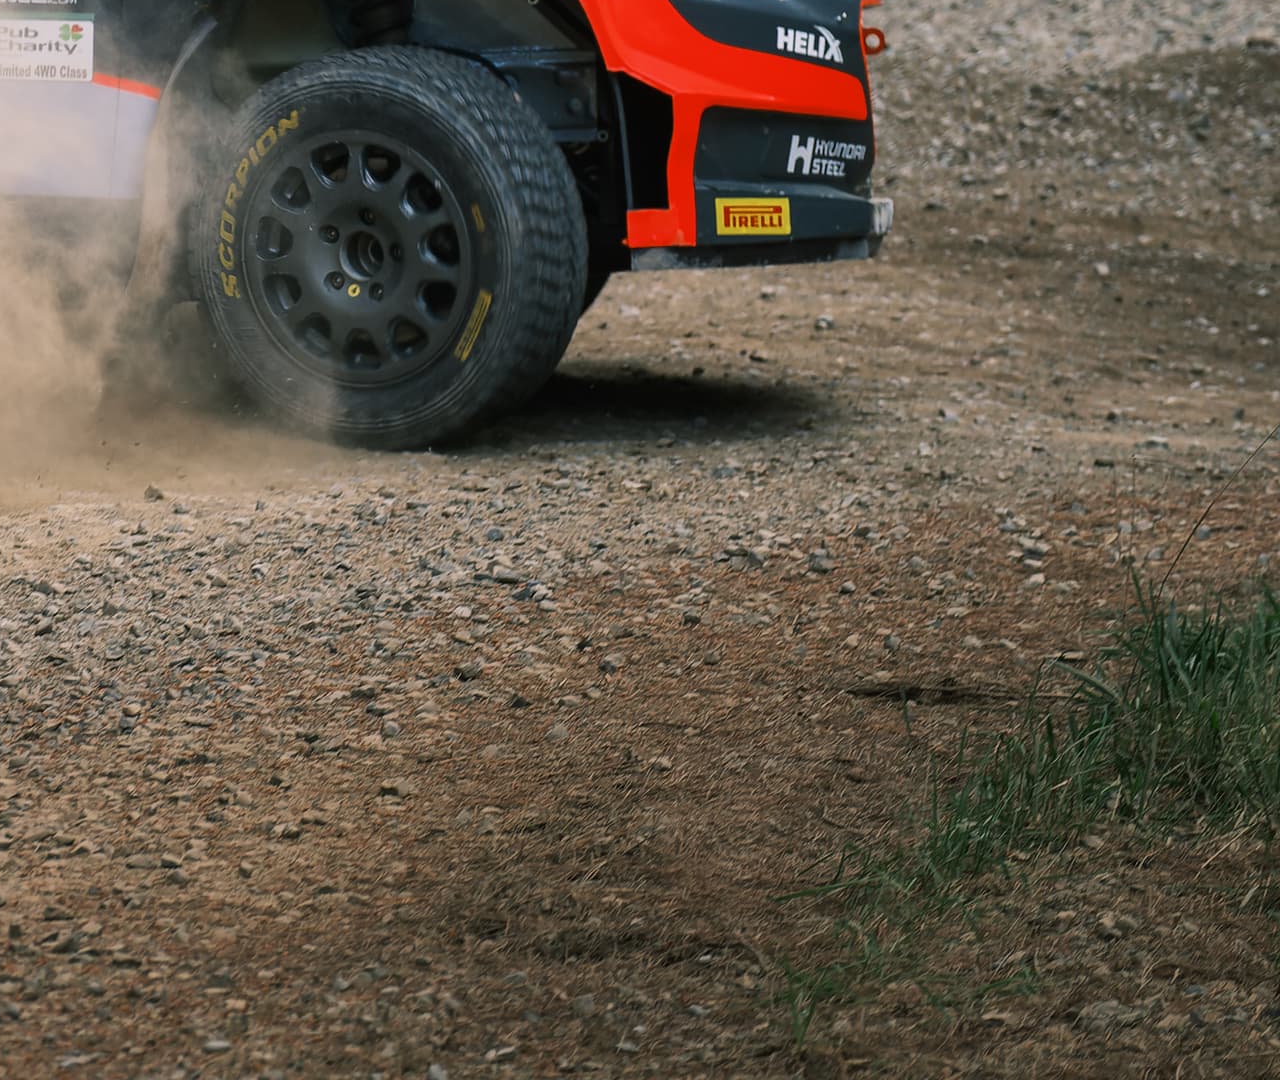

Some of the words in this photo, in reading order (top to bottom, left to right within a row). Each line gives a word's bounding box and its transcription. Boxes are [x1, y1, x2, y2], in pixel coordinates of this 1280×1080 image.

[776, 24, 844, 64] HELIX
[34, 64, 57, 78] 4WD
[60, 65, 88, 79] Class
[815, 139, 867, 161] HYUNDAI
[811, 158, 846, 177] STEEL
[219, 109, 302, 299] SCORPION
[723, 205, 783, 228] PIRELLI
